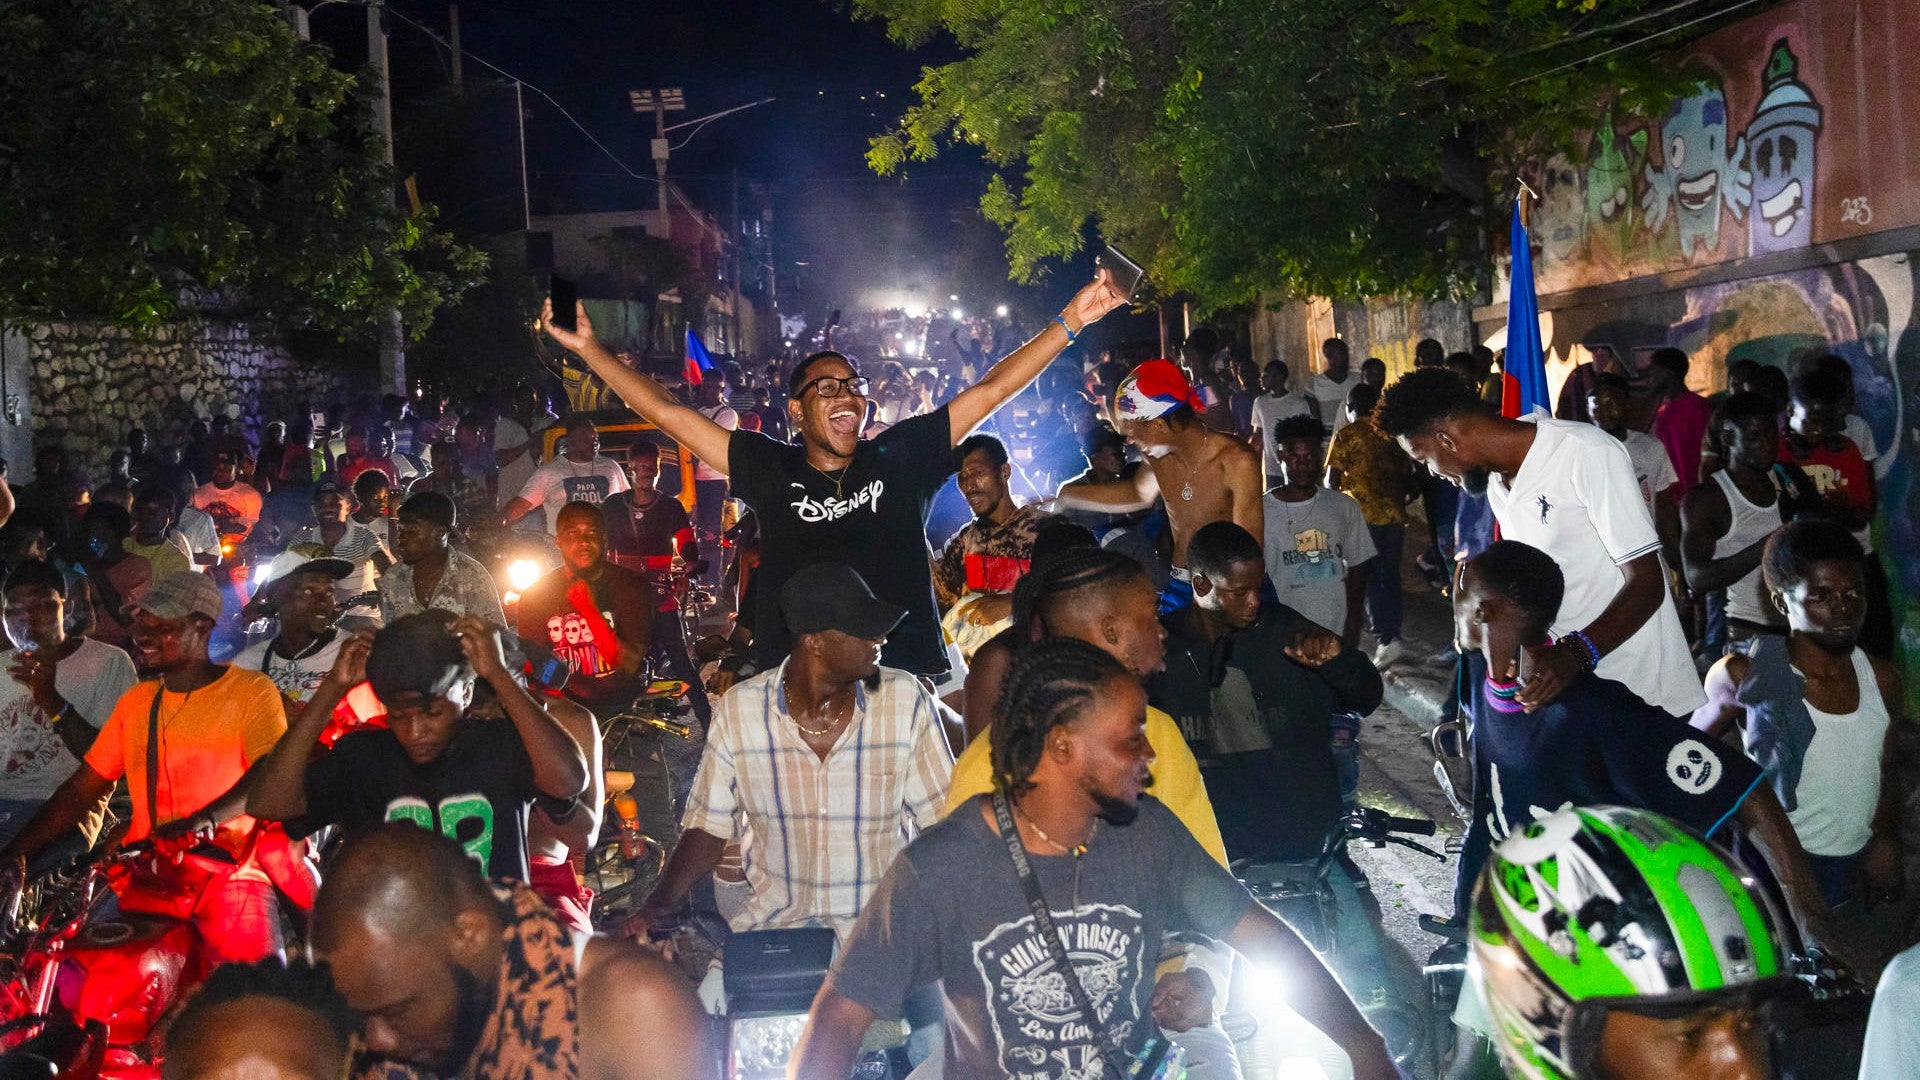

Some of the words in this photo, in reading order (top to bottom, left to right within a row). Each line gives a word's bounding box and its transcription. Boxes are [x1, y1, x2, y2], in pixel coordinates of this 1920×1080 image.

[576, 483, 596, 491] PAPA
[1006, 834, 1031, 878] YOUNG
[1077, 923, 1130, 958] ROSES
[1020, 1020, 1054, 1041] Los
